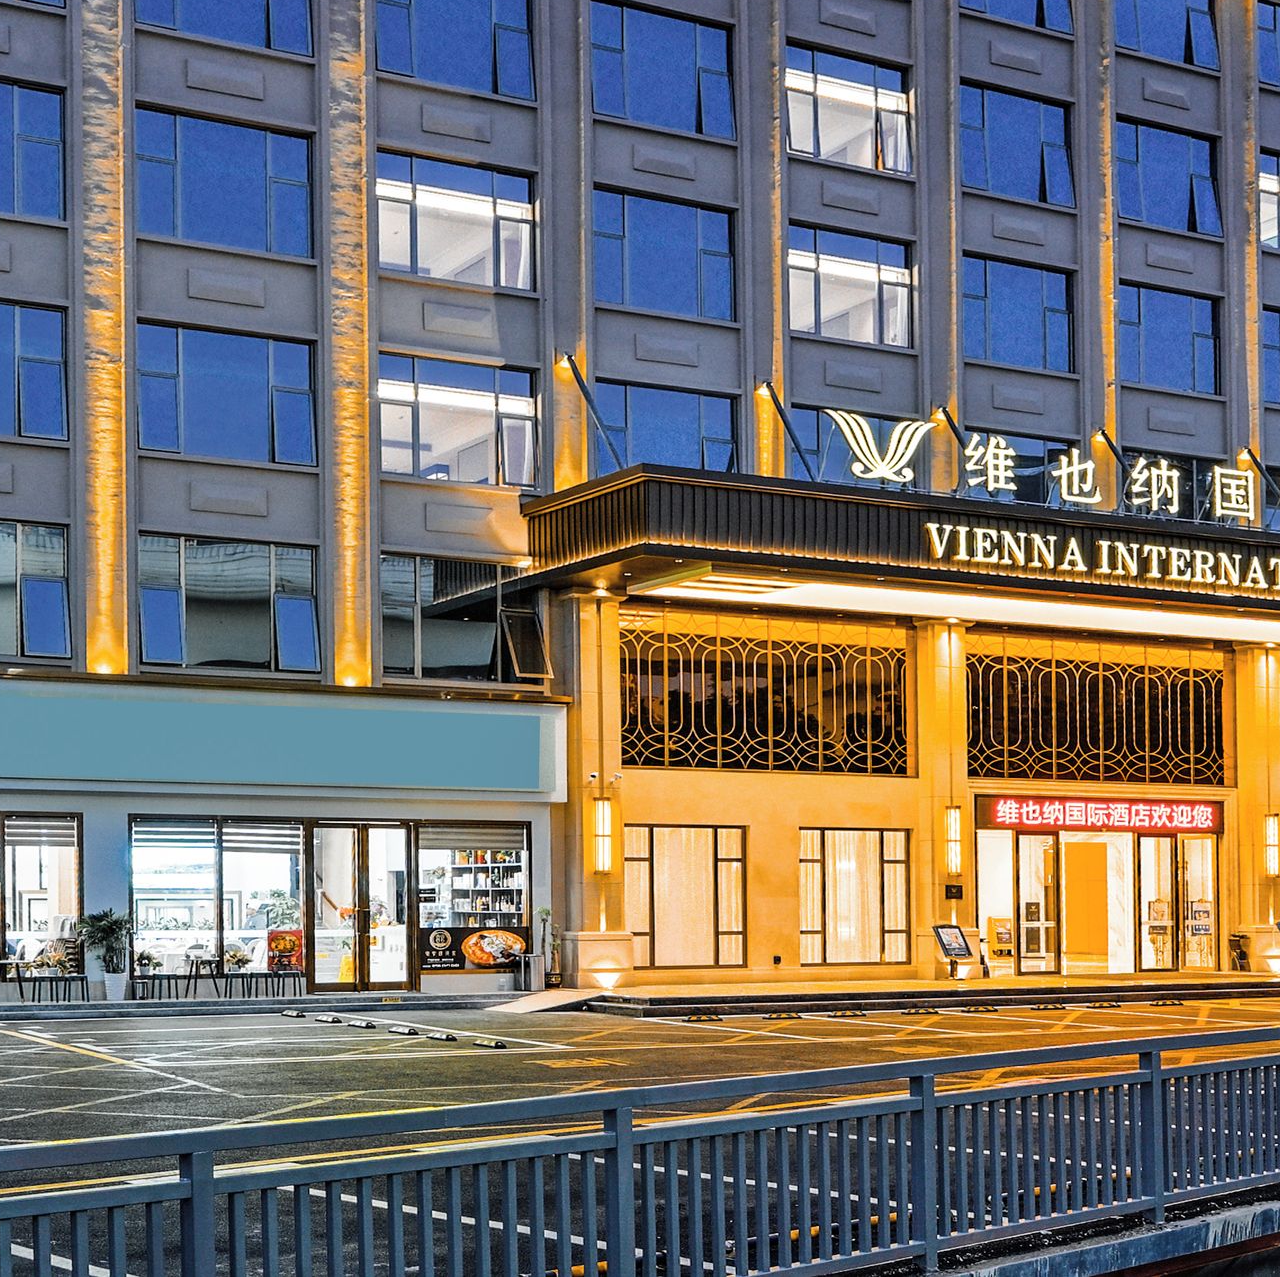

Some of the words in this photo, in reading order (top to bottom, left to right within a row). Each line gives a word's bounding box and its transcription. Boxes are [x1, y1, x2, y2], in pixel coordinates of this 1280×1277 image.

[925, 522, 1088, 573] VIENNA
[996, 799, 1213, 828] 维也纳国际酒店欢迎您
